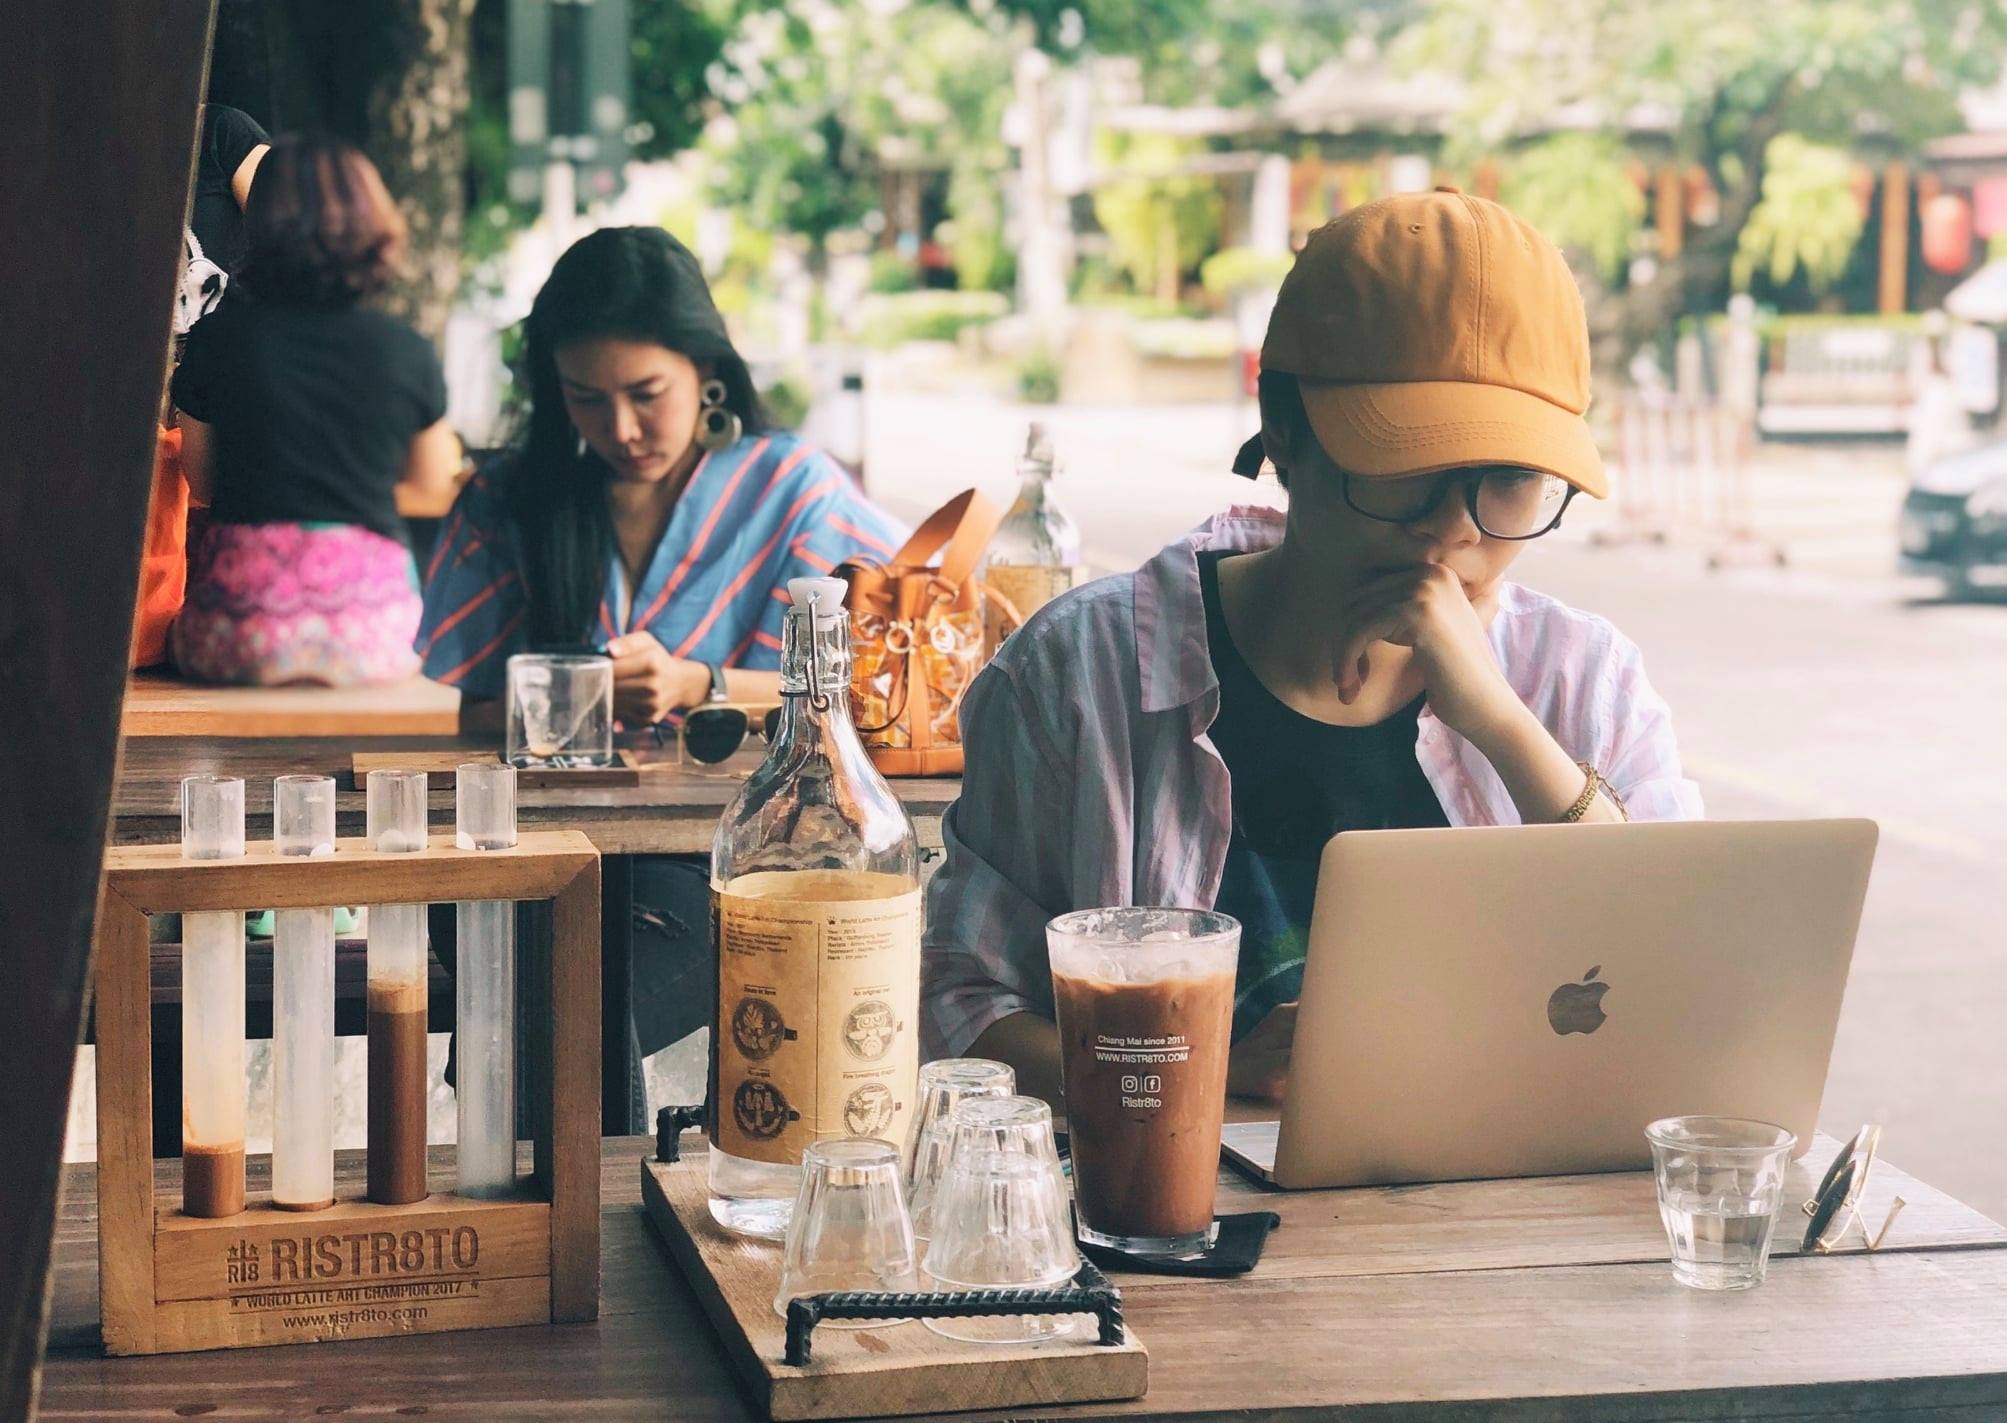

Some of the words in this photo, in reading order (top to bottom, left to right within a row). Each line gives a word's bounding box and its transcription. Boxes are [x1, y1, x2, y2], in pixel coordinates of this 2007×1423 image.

[1097, 1035, 1125, 1046] Chiang
[1126, 1037, 1142, 1046] Mai
[1143, 1037, 1166, 1046] since
[1167, 1036, 1185, 1045] 2011
[1096, 1052, 1188, 1063] WWW.RISTR8TO.COM
[1122, 1097, 1161, 1108] Ristr8to
[271, 1225, 479, 1282] RISTR8TO
[247, 1293, 292, 1308] WORLD
[295, 1290, 334, 1305] LATTE
[337, 1287, 360, 1302] ART
[364, 1283, 430, 1299] CHAMPION
[432, 1281, 462, 1296] 2017
[283, 1305, 428, 1328] www.ristr8to.com
